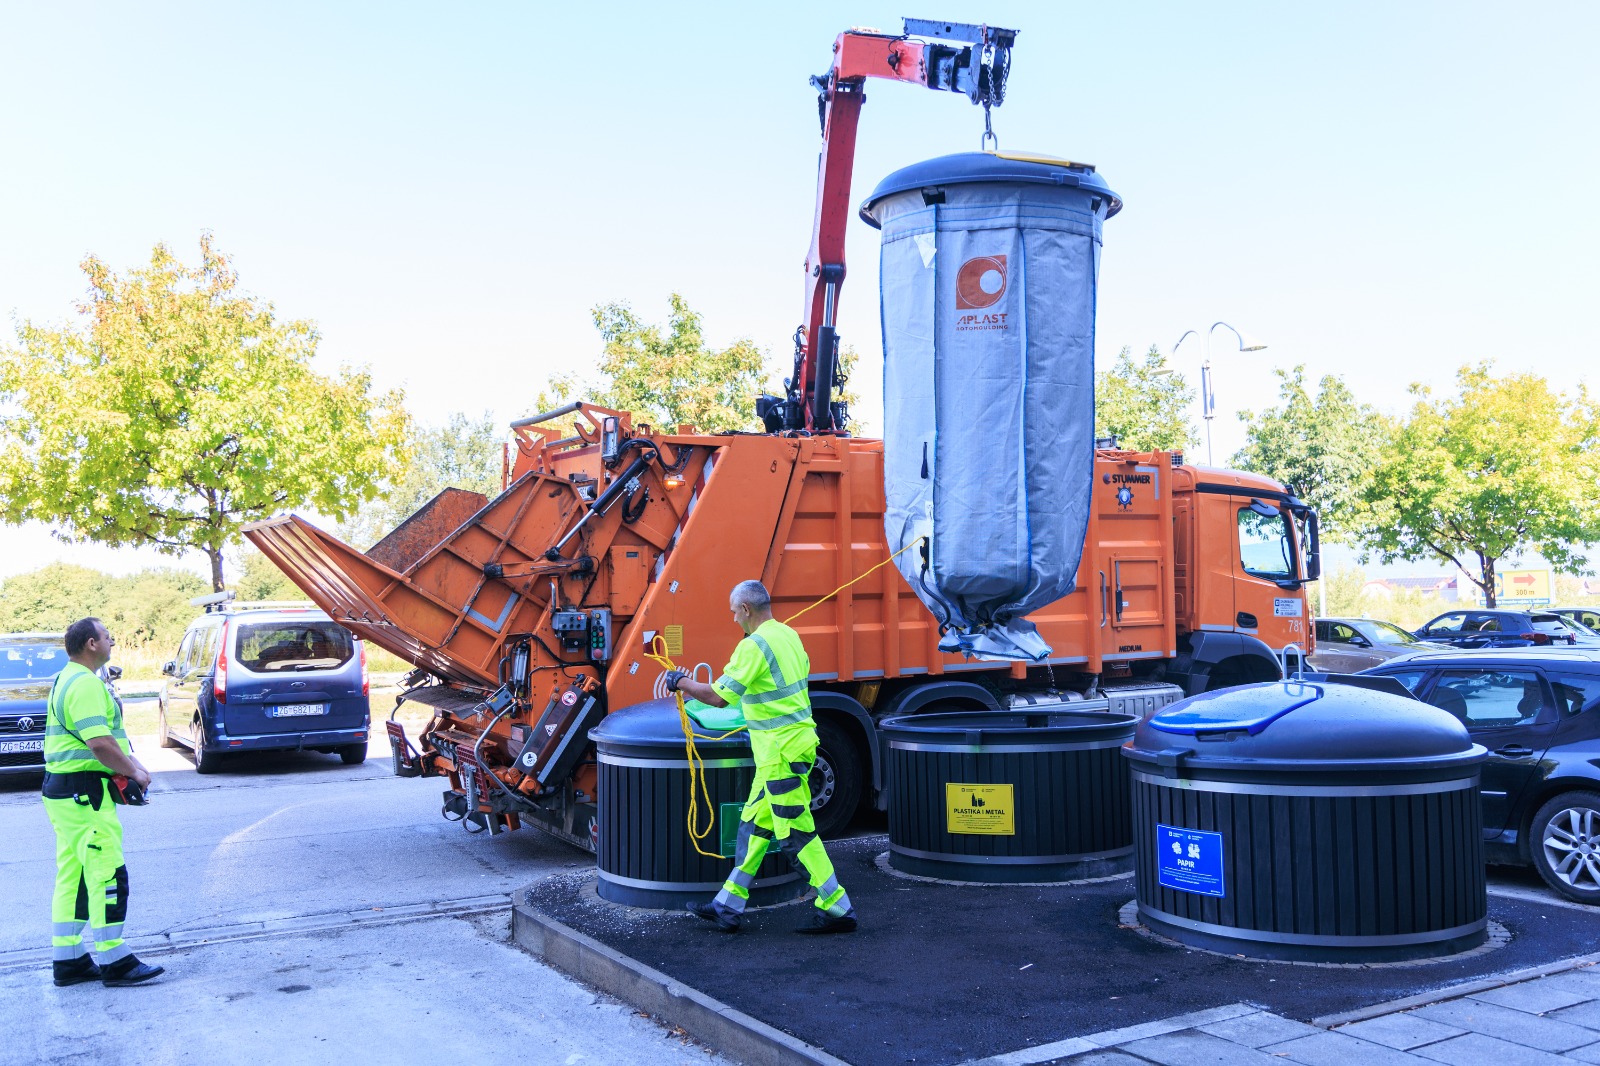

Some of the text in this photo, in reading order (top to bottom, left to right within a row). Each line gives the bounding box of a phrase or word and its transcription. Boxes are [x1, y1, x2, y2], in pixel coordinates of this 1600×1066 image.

[956, 313, 1008, 325] APLAST
[1112, 474, 1151, 484] STUMMER
[1288, 620, 1303, 633] 781
[1119, 645, 1142, 653] MEDIUM
[279, 706, 289, 715] ZG
[2, 742, 13, 752] ZG
[1177, 858, 1195, 868] PAPIR
